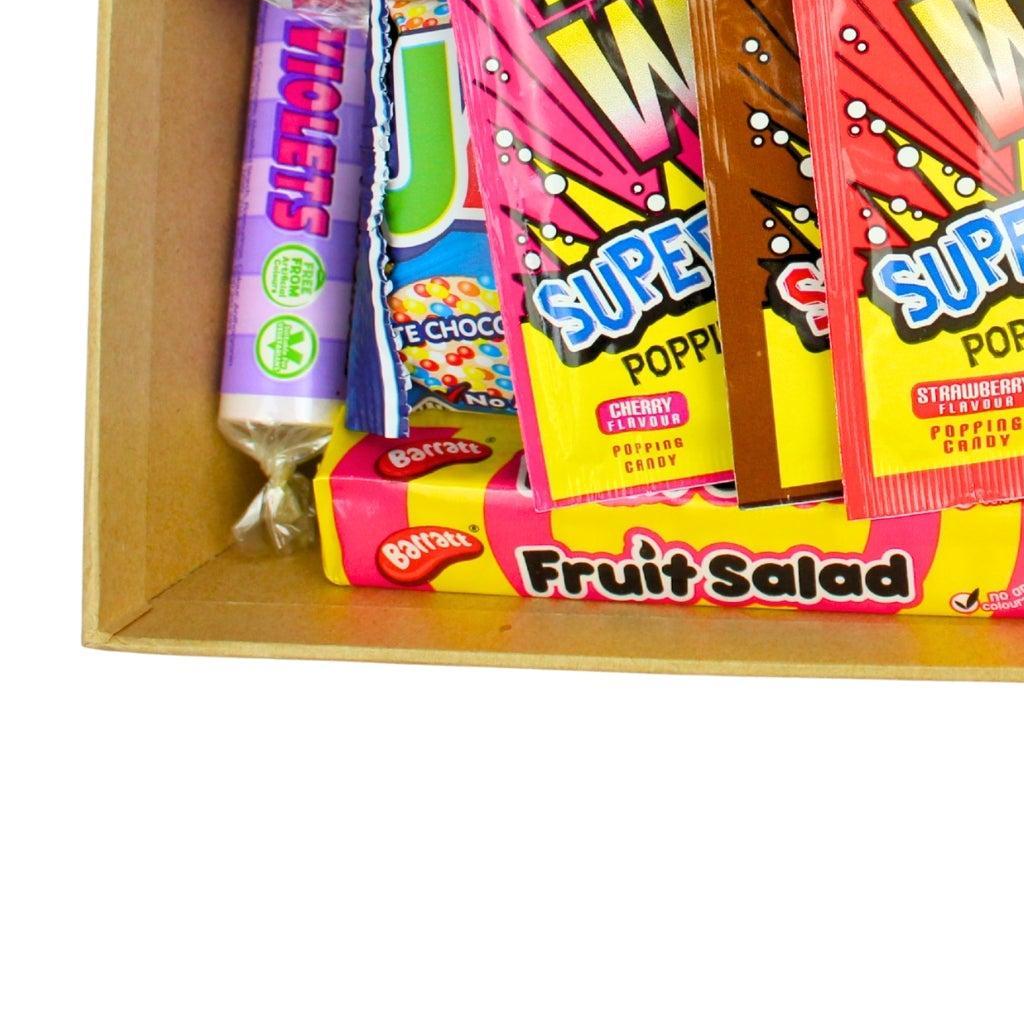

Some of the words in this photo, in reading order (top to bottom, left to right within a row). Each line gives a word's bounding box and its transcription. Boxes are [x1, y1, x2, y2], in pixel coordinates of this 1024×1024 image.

[265, 19, 347, 238] VIOLETS
[289, 257, 303, 298] FROM
[302, 261, 315, 295] FREE
[621, 321, 722, 386] POPPI
[608, 396, 673, 419] CHERRY
[939, 393, 1015, 415] FLAVOUR
[607, 413, 681, 433] FLAVOUR
[930, 416, 1024, 440] POPPING
[388, 439, 482, 468] Barratt
[612, 437, 685, 458] POPPING
[943, 432, 1011, 455] CANDY
[625, 454, 678, 474] CANDY
[382, 532, 473, 572] Barratt
[520, 536, 698, 598] Fruit
[707, 551, 911, 600] Salad
[988, 592, 1009, 602] no
